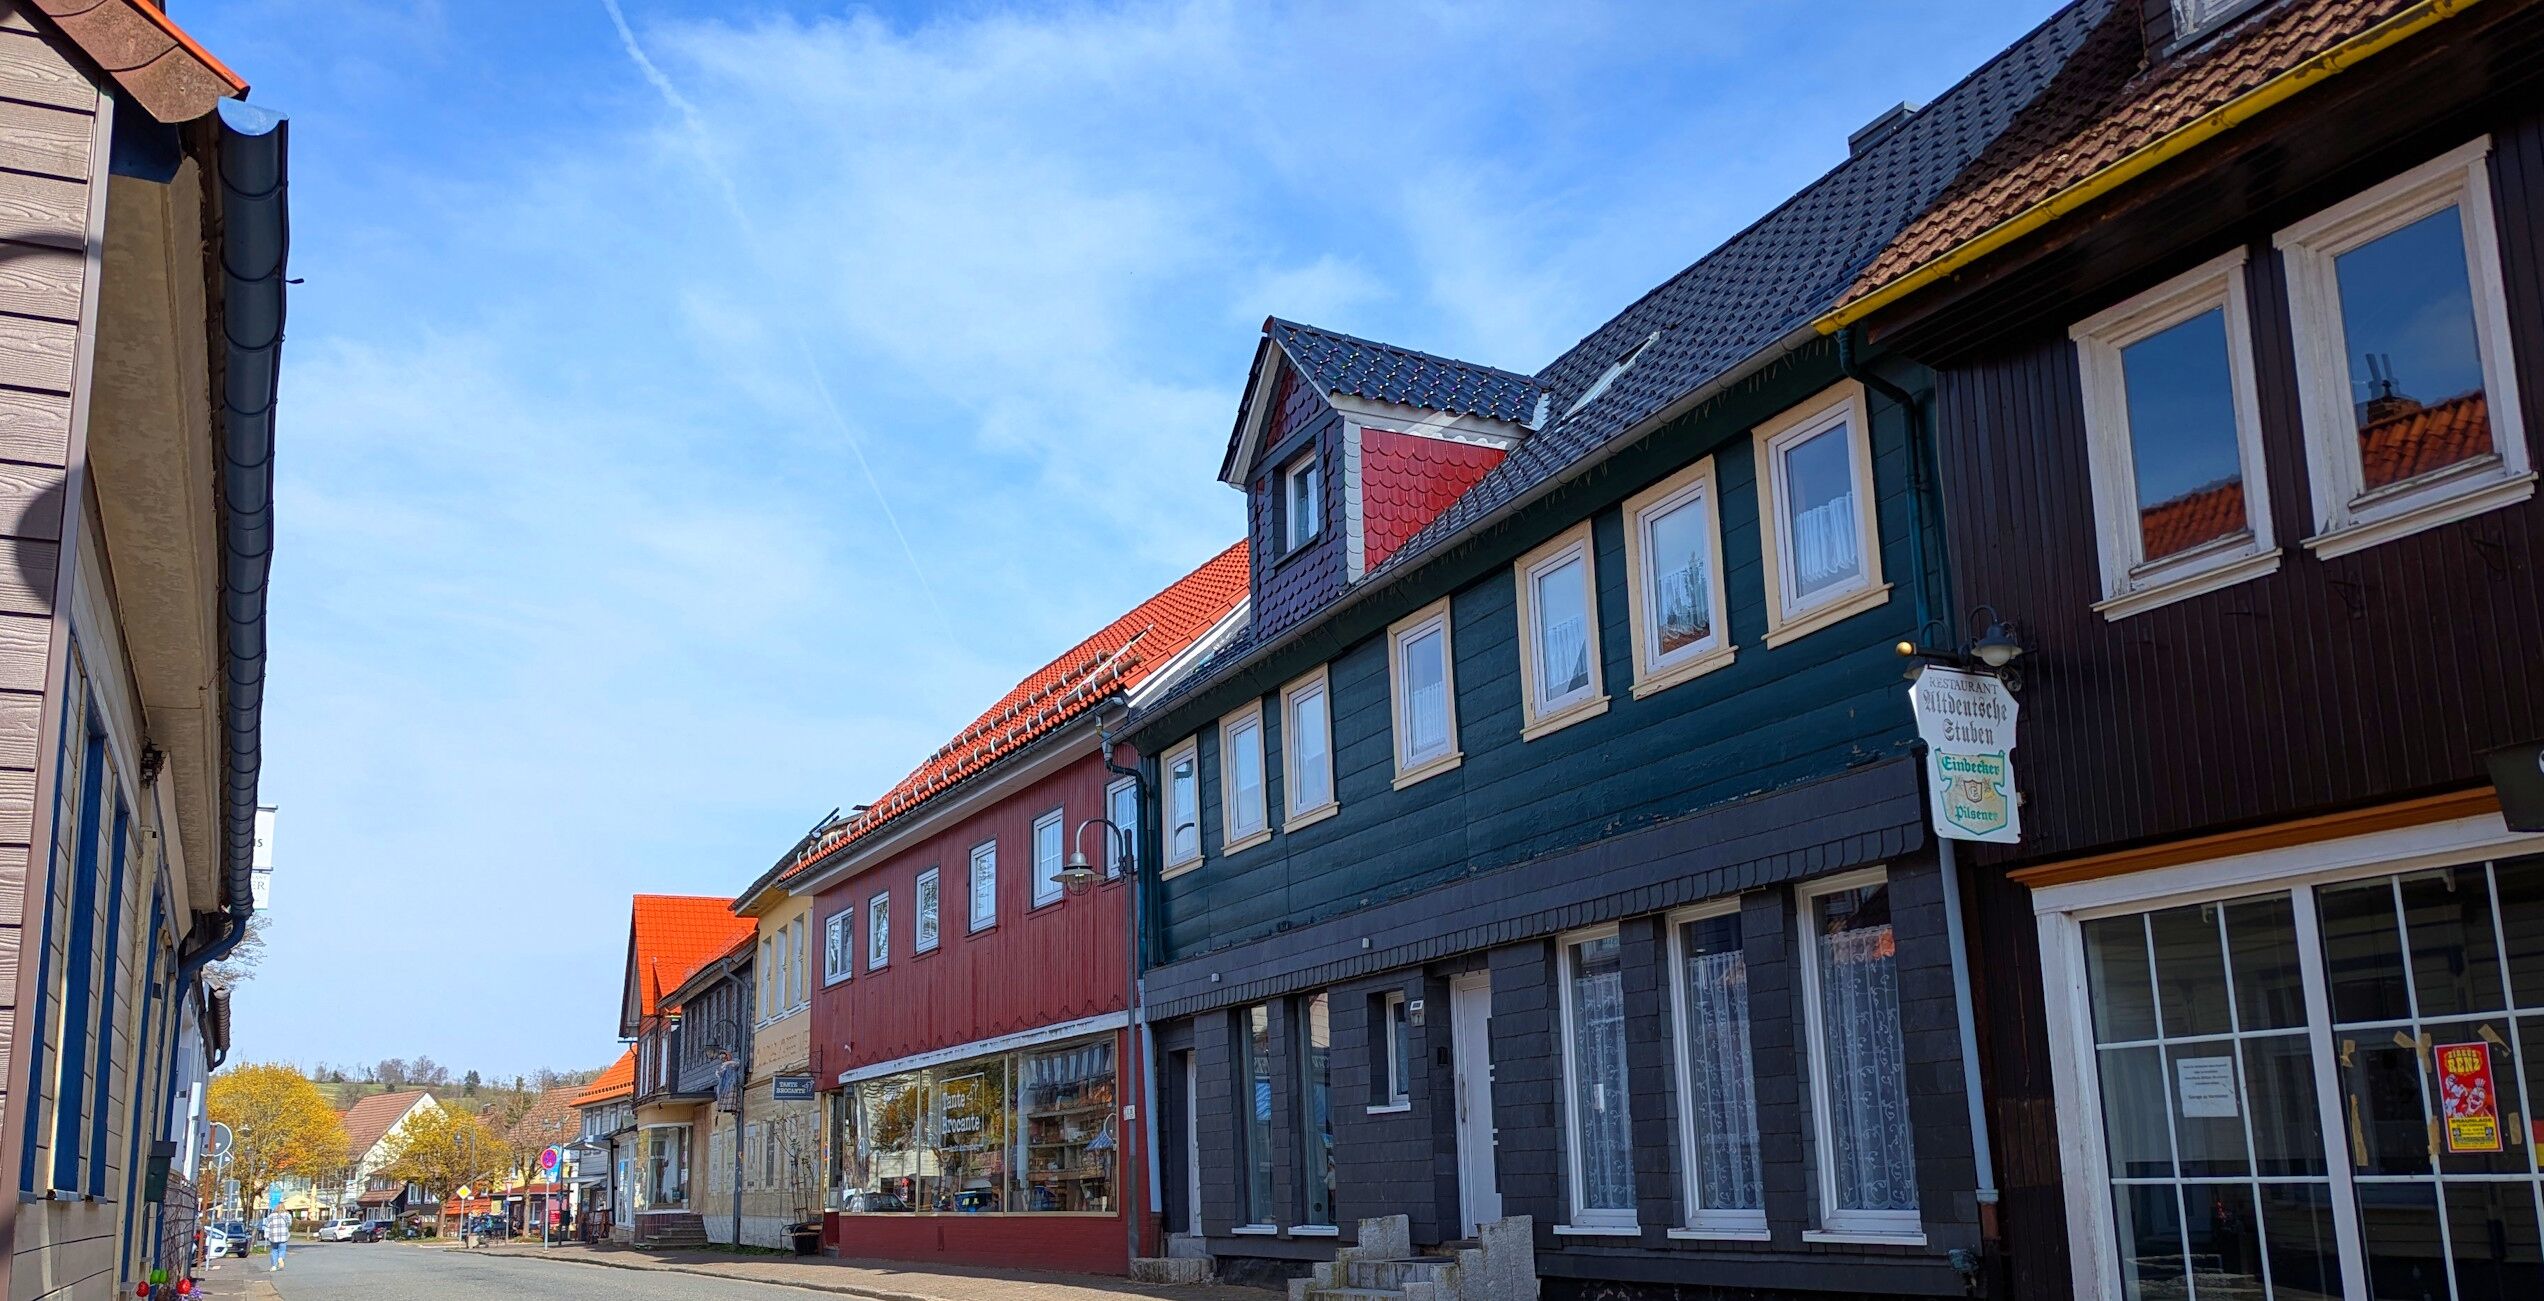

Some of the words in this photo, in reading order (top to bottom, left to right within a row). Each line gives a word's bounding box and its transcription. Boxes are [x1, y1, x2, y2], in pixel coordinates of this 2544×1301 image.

[1929, 676, 1999, 694] RESTAURANT
[1923, 690, 2008, 726] Altdeutsche
[1944, 718, 1994, 746] Stuben
[1941, 755, 2000, 775] Einbecker
[1955, 805, 1999, 822] Pilsener
[2448, 1057, 2480, 1072] RENZ
[942, 1090, 965, 1110] Tante
[942, 1113, 980, 1134] Brocante
